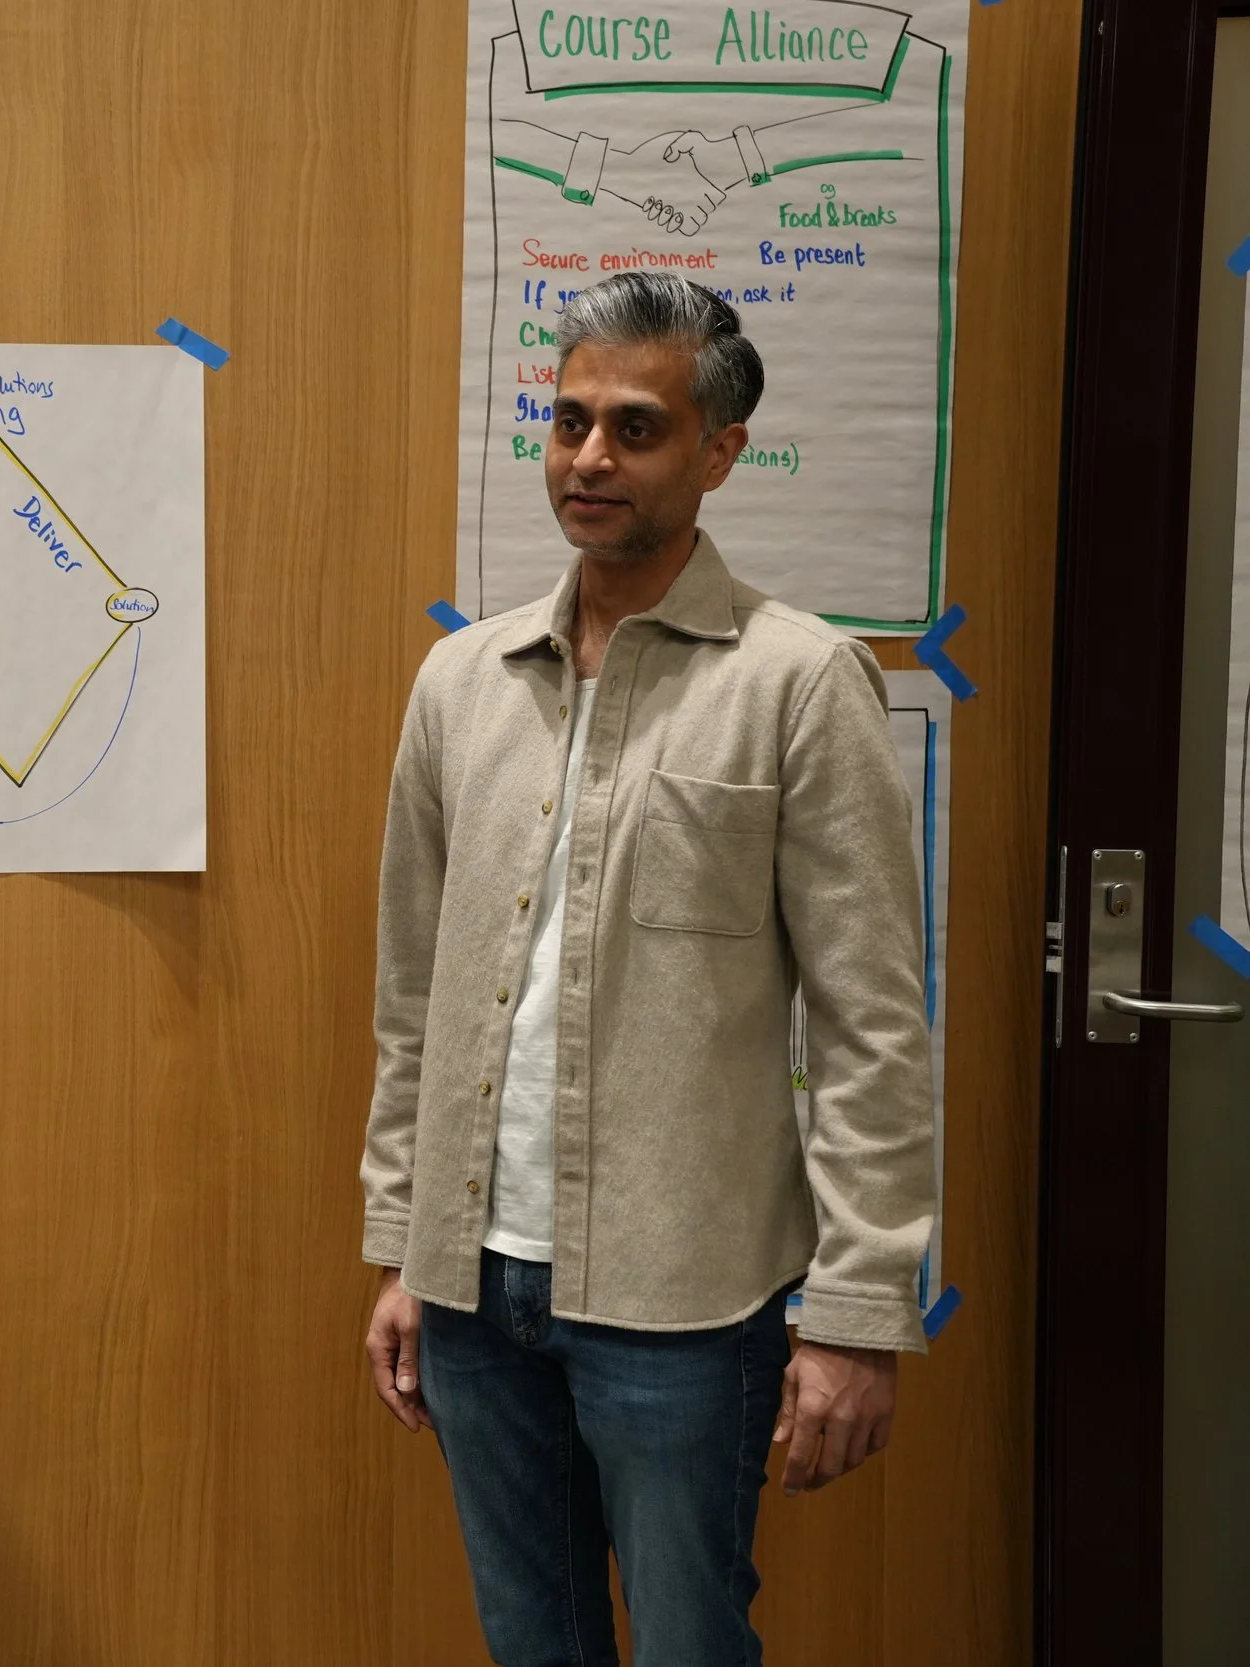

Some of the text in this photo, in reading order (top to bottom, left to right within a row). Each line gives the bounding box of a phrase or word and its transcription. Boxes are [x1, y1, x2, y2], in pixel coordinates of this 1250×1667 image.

[539, 7, 869, 65] Course Alliance
[779, 202, 822, 228] Food
[522, 238, 718, 271] Secure environment
[759, 241, 866, 272] Be present
[524, 280, 547, 310] If
[743, 284, 772, 303] ask
[780, 281, 796, 302] it
[517, 362, 557, 385] List
[514, 392, 555, 422] Sha
[512, 434, 542, 461] Be
[12, 495, 83, 574] Deliver
